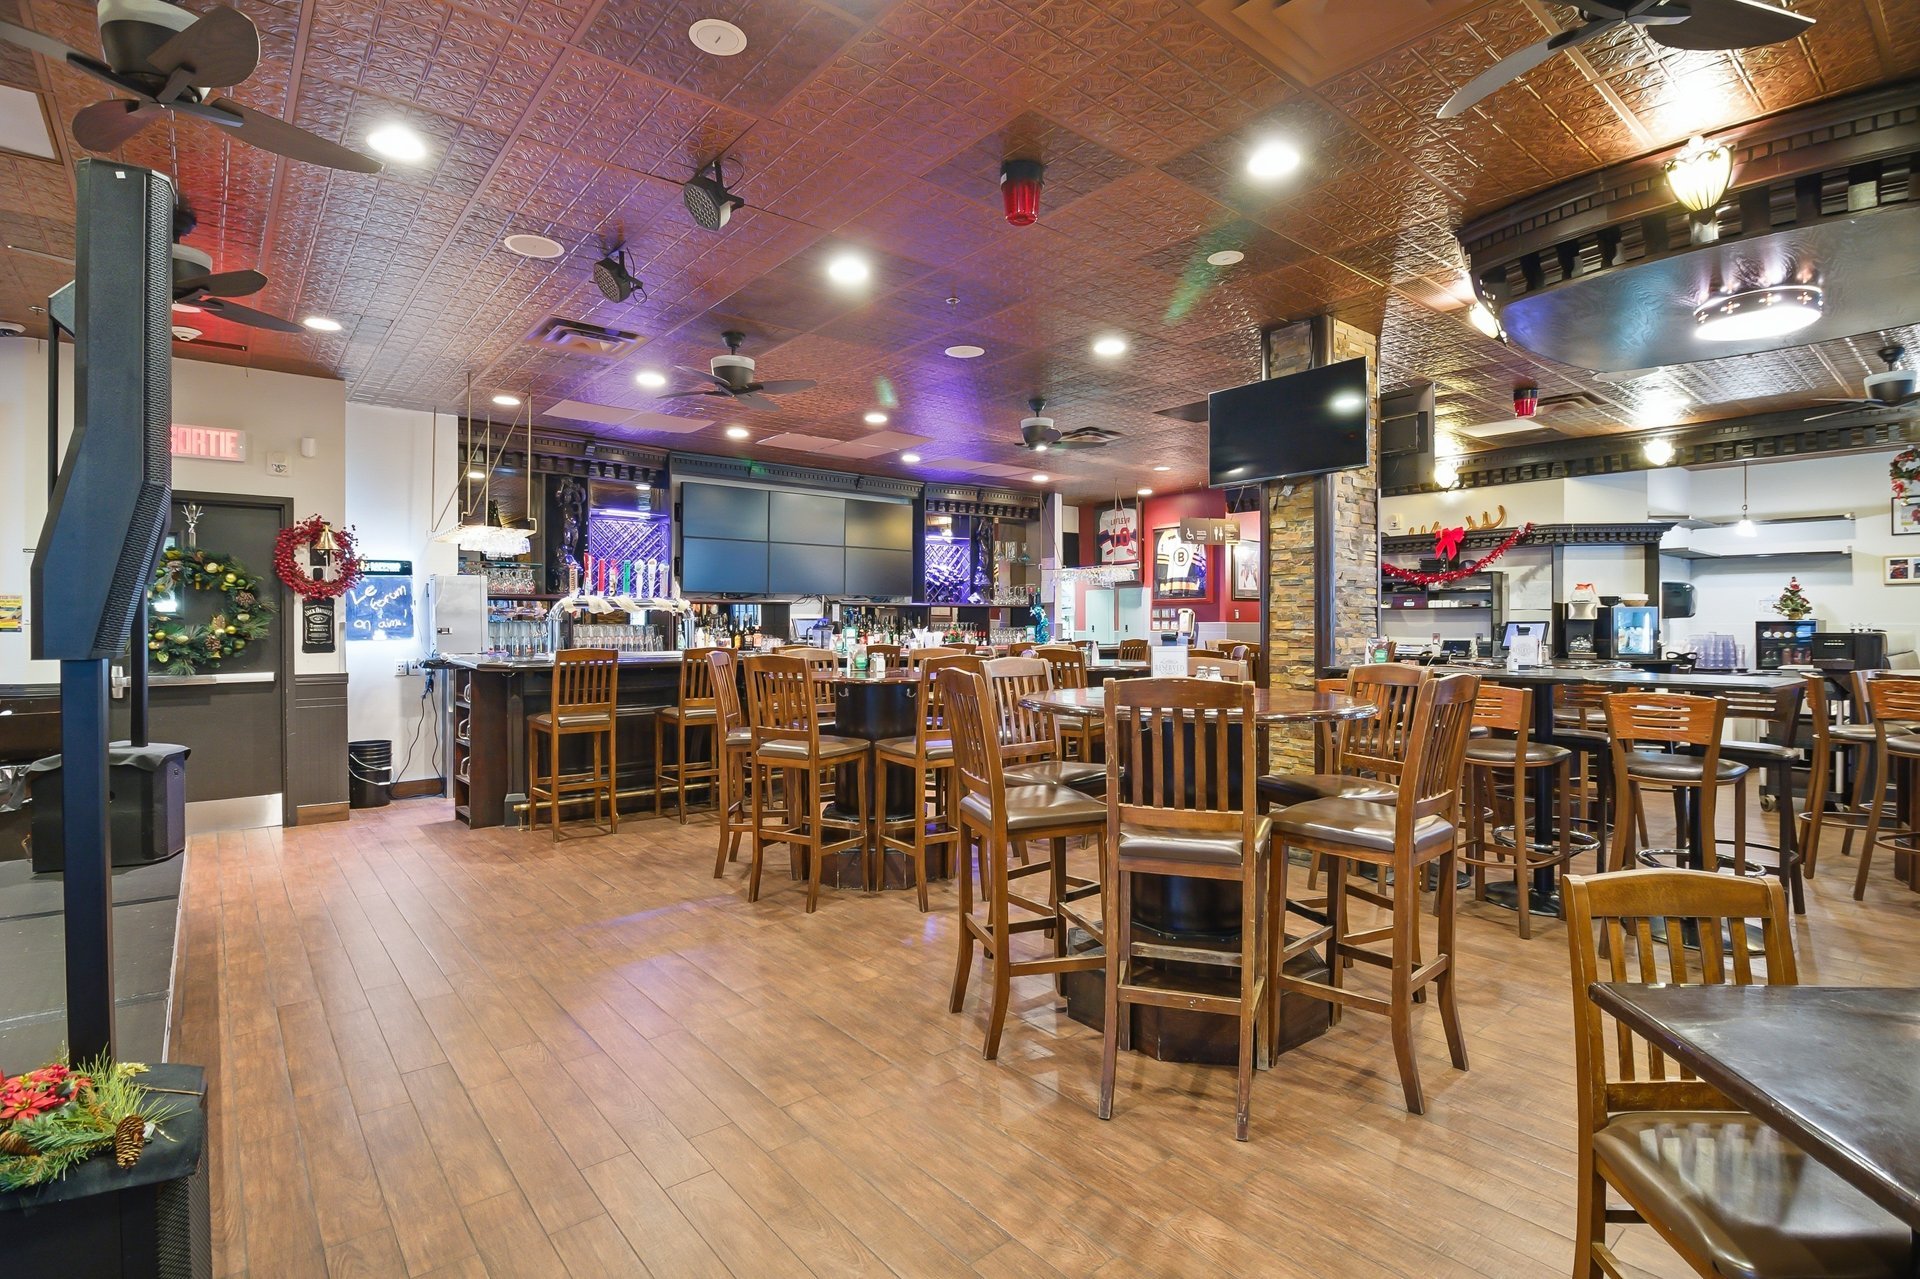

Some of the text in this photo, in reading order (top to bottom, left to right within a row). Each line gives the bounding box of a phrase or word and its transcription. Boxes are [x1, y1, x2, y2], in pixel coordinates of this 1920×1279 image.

[1178, 552, 1185, 562] B
[350, 585, 377, 605] Le
[353, 620, 371, 631] on
